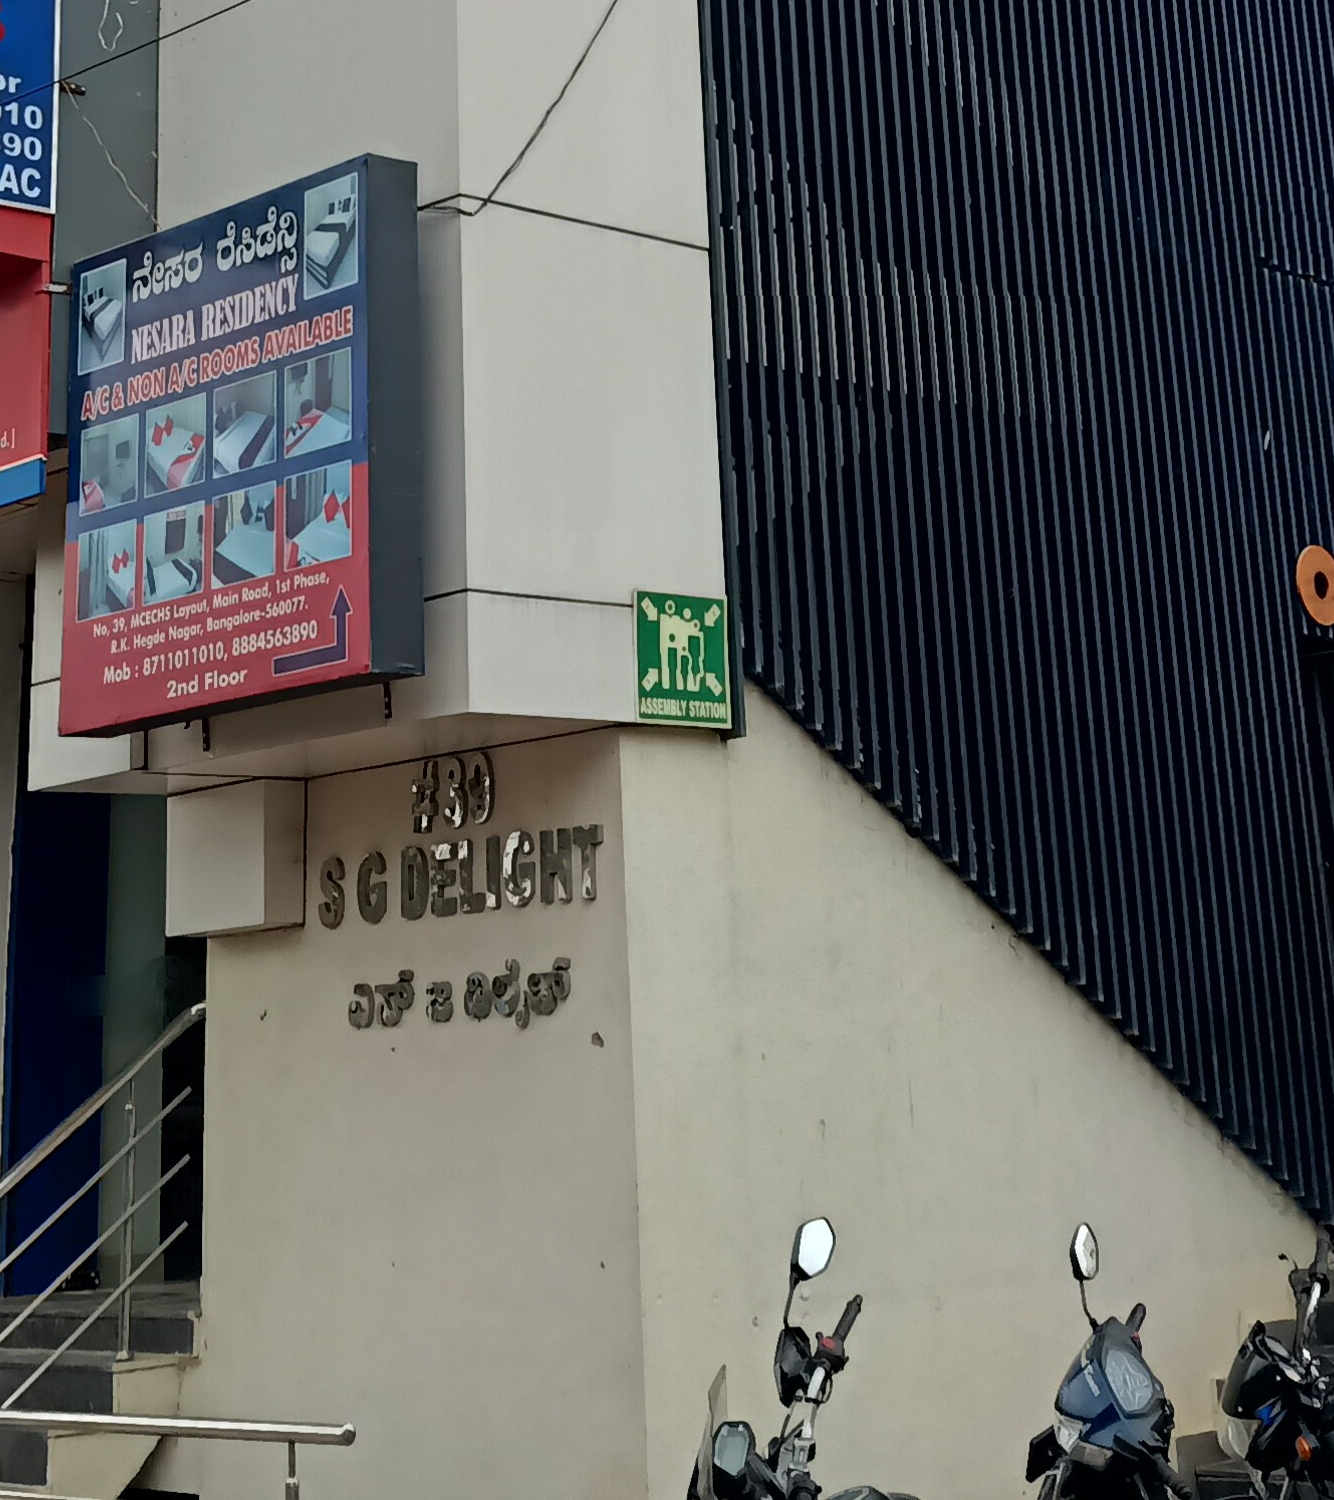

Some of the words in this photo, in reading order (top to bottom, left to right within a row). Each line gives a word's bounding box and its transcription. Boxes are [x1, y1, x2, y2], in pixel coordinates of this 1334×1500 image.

[132, 242, 204, 303] ನೇಸರ
[131, 310, 196, 365] NESARA
[201, 274, 300, 342] RESIDENCY
[81, 390, 110, 422] A/C
[111, 382, 125, 411] &
[127, 368, 166, 407] NON
[168, 359, 198, 393] A/C
[199, 337, 260, 382] ROOMS
[262, 305, 354, 364] AVAILABLE
[130, 608, 171, 630] MCECHS
[173, 596, 210, 622] Layout,
[212, 591, 240, 609] Main
[242, 583, 272, 603] Road,
[275, 578, 292, 595] 1st
[294, 571, 331, 591] Phase,
[111, 637, 131, 654] R.K.
[133, 630, 166, 652] Hegde
[168, 619, 204, 643] Nagar,
[142, 642, 229, 677] 8711011010,
[231, 620, 318, 658] 8884563890
[166, 678, 199, 699] 2nd
[204, 668, 248, 691] Floor
[640, 697, 687, 717] ASSEMBLY
[689, 700, 727, 719] STATION
[318, 856, 346, 930] S
[357, 851, 388, 925] G
[400, 824, 605, 921] DELIGHT
